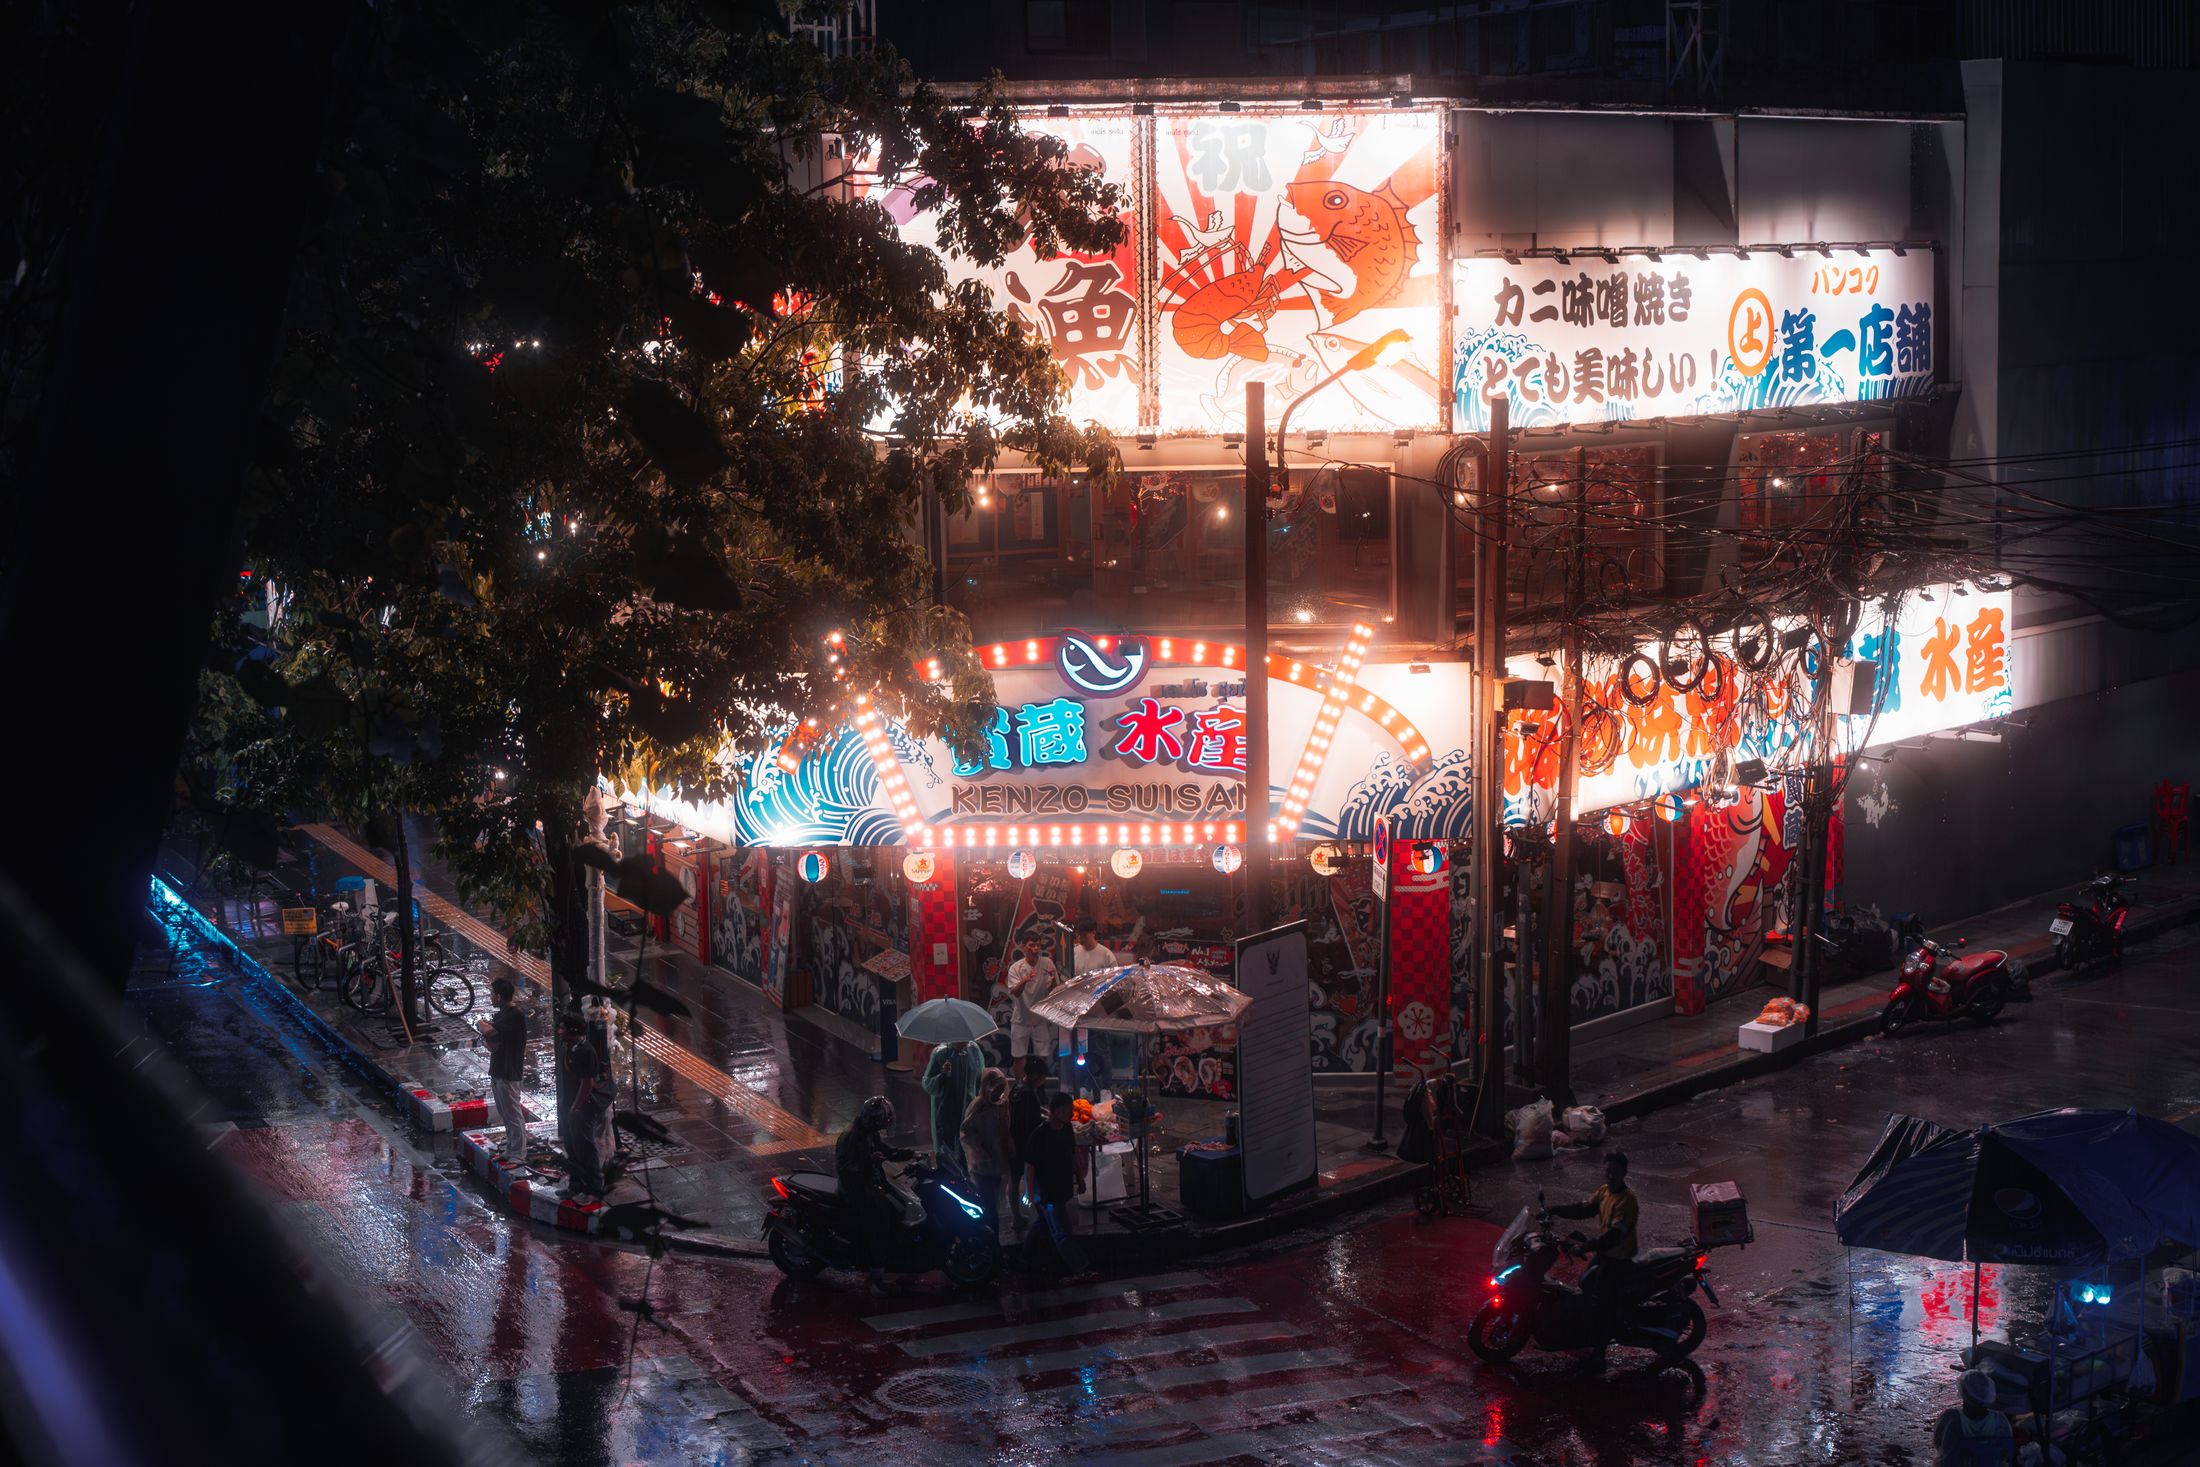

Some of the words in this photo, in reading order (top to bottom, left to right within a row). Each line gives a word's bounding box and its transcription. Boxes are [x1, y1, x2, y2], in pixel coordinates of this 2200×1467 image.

[1190, 121, 1273, 193] 祝
[1494, 270, 1693, 329] カニ味噌焼き
[1811, 263, 1880, 298] バンコク
[1780, 301, 1932, 384] 第一店舗
[1920, 607, 2005, 703] 水産
[1115, 697, 1246, 774] 水産
[951, 783, 1090, 815] KENZO
